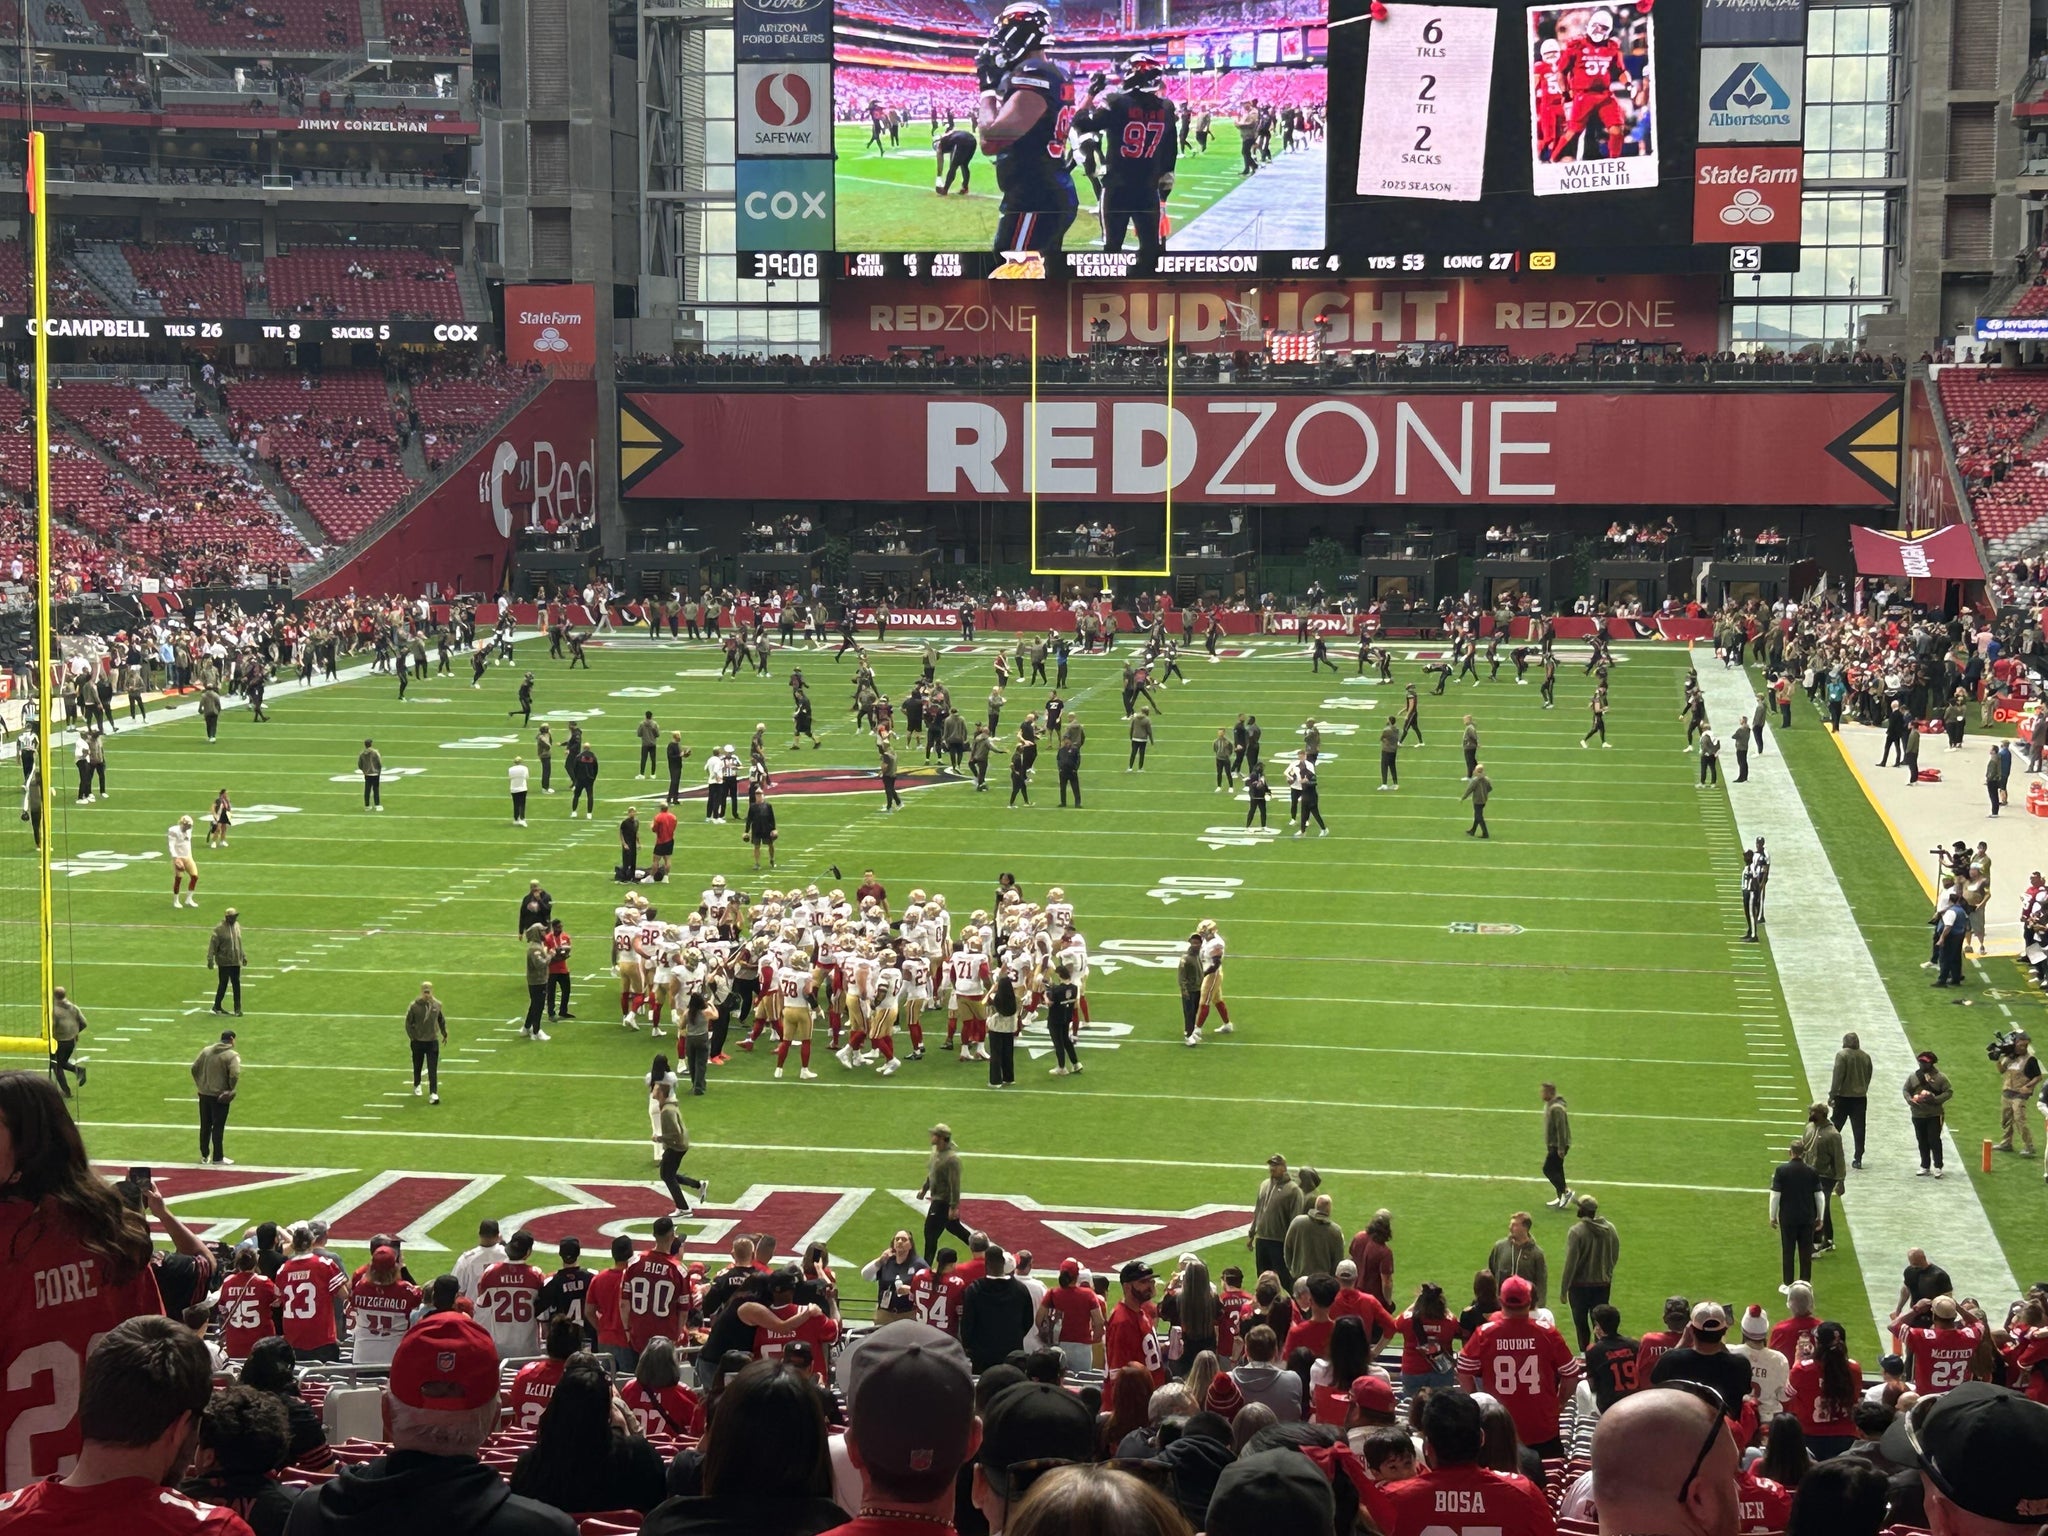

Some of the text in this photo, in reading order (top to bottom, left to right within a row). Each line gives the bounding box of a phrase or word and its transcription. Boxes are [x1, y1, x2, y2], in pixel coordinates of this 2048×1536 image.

[759, 23, 808, 33] ARIZONA
[1423, 18, 1443, 45] 6
[742, 34, 825, 44] FORD DEALERS
[1416, 47, 1446, 58] TKLS
[1418, 75, 1437, 101] 2
[1416, 104, 1436, 115] TFL
[298, 119, 428, 133] JIMMY CONZELMAN
[1709, 113, 1791, 126] Albertsons
[755, 132, 811, 143] SAFEWAY
[1121, 121, 1166, 158] 97
[1414, 126, 1432, 151] 2
[1401, 154, 1442, 165] SACKS
[1565, 161, 1627, 177] WALTER
[1408, 181, 1452, 192] SEASON
[1560, 173, 1630, 190] NOLEN III
[744, 190, 826, 220] COX
[754, 253, 818, 277] 39:08
[856, 253, 960, 266] CHI 16 4TH
[1066, 254, 1137, 266] RECEIVING
[1155, 253, 1514, 273] JEFFERSON REC 4 YDS 53 LONG 27
[1733, 249, 1758, 269] 25
[857, 265, 884, 276] MIN
[908, 265, 918, 277] 3
[1076, 265, 1127, 277] LEADER
[1082, 290, 1449, 344] BUD LIGHT
[45, 319, 150, 338] CAMPBELL
[164, 324, 196, 337] TKLS
[201, 322, 223, 338] 26
[262, 326, 285, 338] TFL
[289, 324, 300, 339] 8
[331, 327, 374, 339] SACKS
[379, 325, 390, 340] 5
[433, 325, 478, 341] COX
[926, 400, 1558, 496] REDZONE
[532, 439, 596, 528] Red
[856, 613, 958, 626] CADINALS
[957, 961, 972, 980] 71
[644, 1261, 670, 1276] RICE
[34, 1259, 98, 1310] GORE
[500, 1274, 524, 1284] WELLS
[283, 1282, 317, 1320] 13
[354, 1296, 407, 1310] FITZGERALD
[494, 1290, 533, 1323] 26
[631, 1276, 675, 1318] 80
[915, 1289, 949, 1329] 54
[1496, 1338, 1537, 1351] BOURNE
[1493, 1354, 1541, 1396] 84
[1609, 1360, 1641, 1392] 19
[1931, 1361, 1968, 1387] 23
[1434, 1490, 1486, 1513] BOSA
